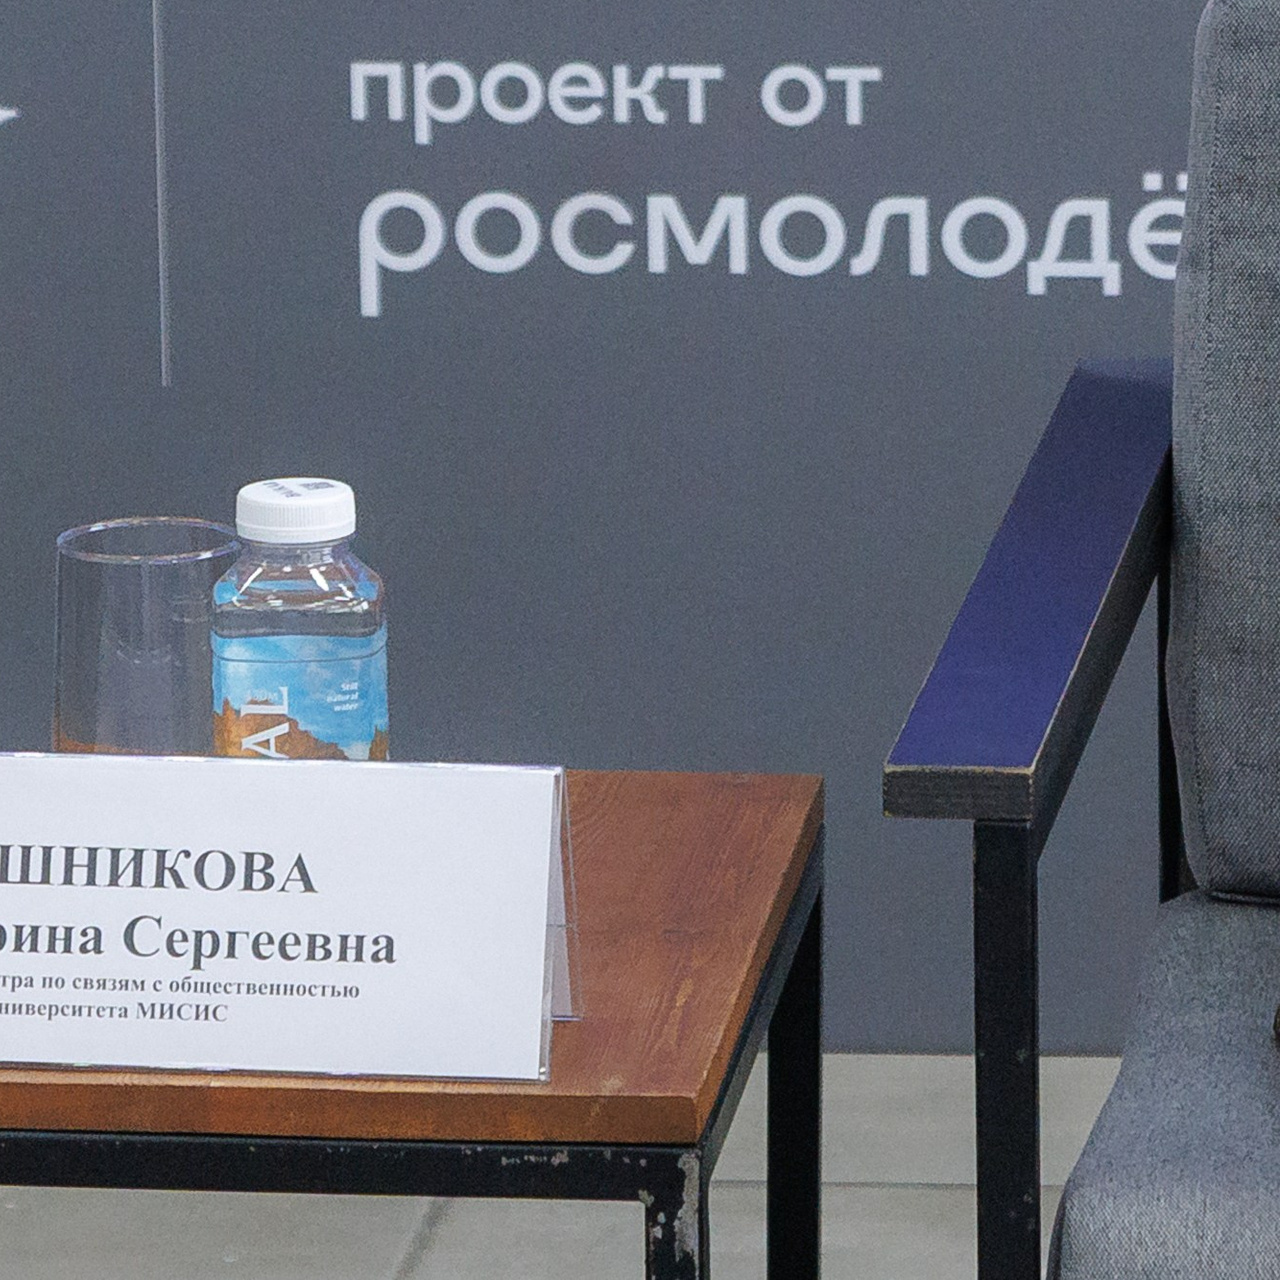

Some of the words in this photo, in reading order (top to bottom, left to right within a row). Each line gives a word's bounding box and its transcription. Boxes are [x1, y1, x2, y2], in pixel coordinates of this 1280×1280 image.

[349, 60, 724, 146] проект
[761, 64, 882, 126] от
[123, 915, 397, 971] Сергеевна
[42, 976, 66, 989] по
[72, 977, 145, 992] связям
[153, 980, 163, 992] с
[169, 976, 360, 999] общественностью
[136, 1002, 229, 1022] МИСИС
